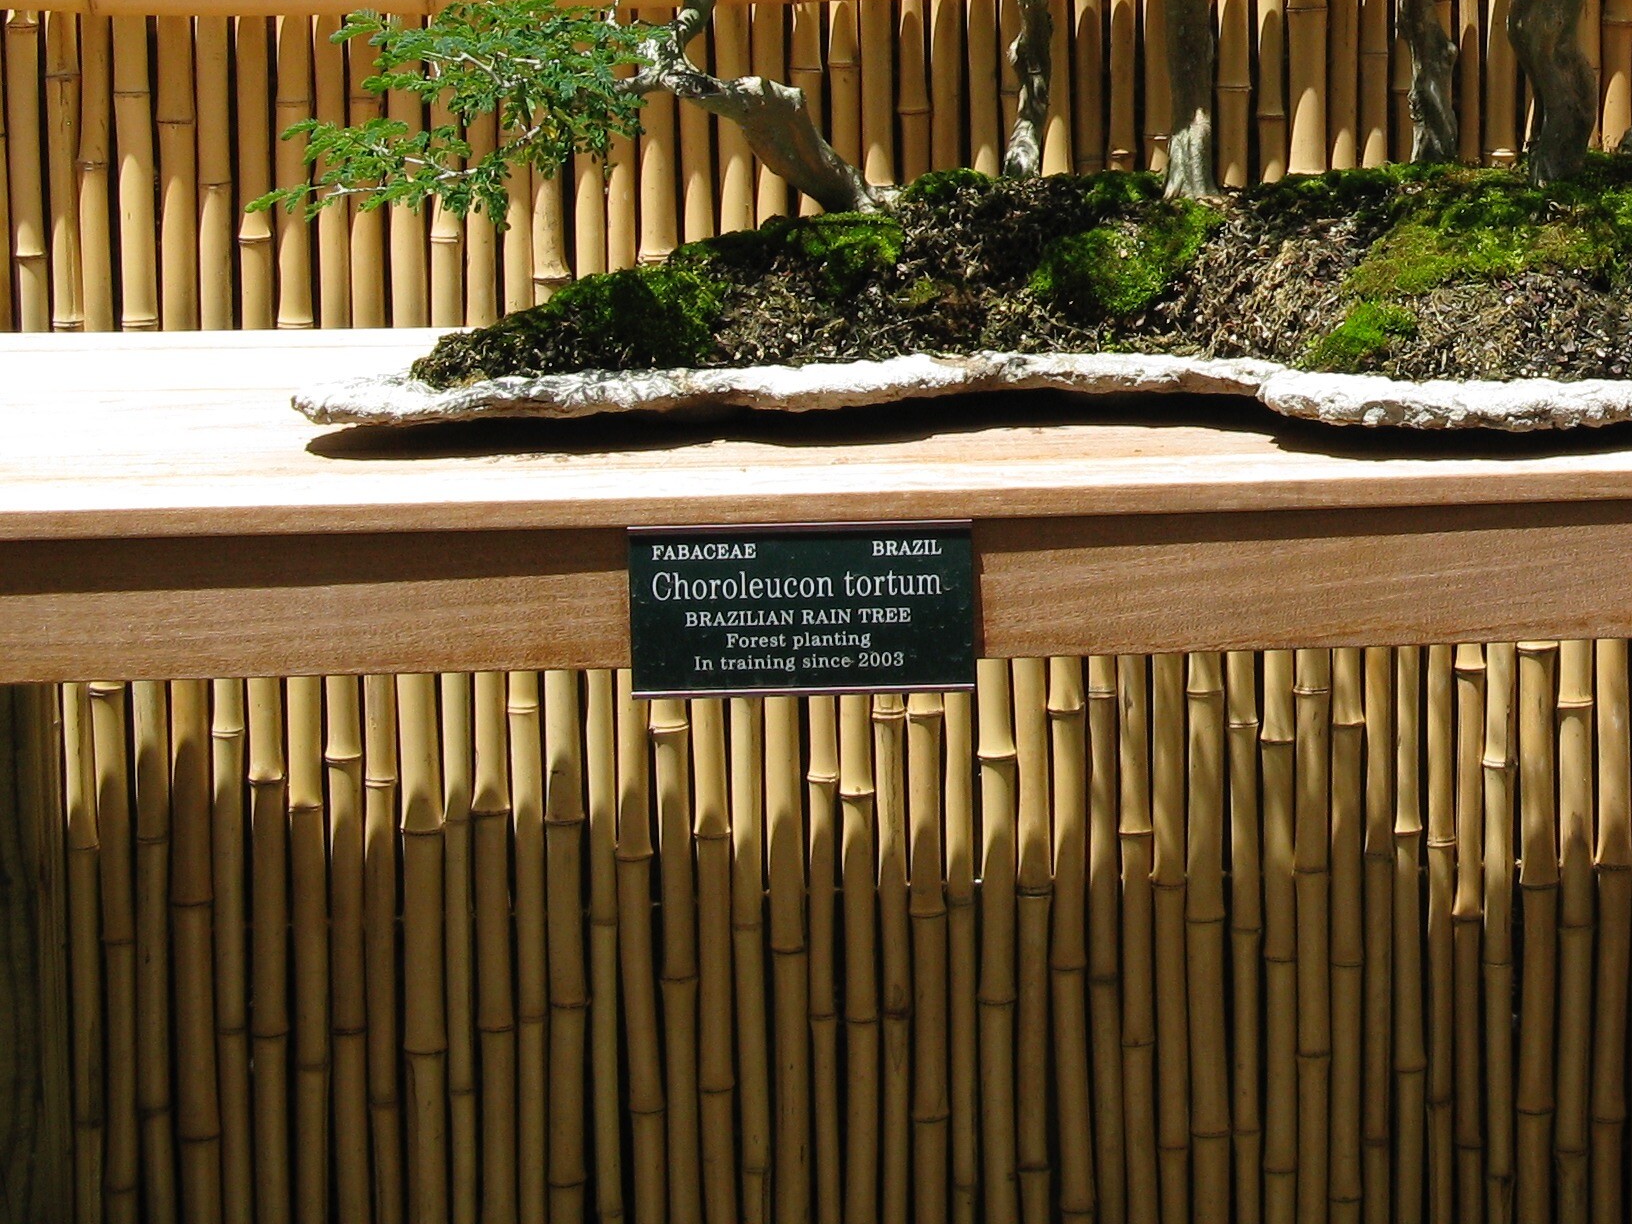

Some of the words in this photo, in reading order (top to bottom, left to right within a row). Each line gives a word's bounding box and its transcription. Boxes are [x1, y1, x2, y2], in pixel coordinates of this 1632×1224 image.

[652, 543, 756, 560] FABACEAE
[872, 540, 942, 556] BRAZIL
[653, 571, 833, 600] Choroleucon
[844, 570, 942, 596] tortum
[685, 610, 794, 626] BRAZILIAN
[802, 609, 851, 624] RAIN
[858, 608, 910, 623] TREE
[727, 634, 786, 648] Forest
[793, 631, 870, 650] planting
[695, 656, 713, 670] In
[721, 655, 795, 671] training
[803, 655, 853, 668] since
[859, 652, 903, 667] 2003
